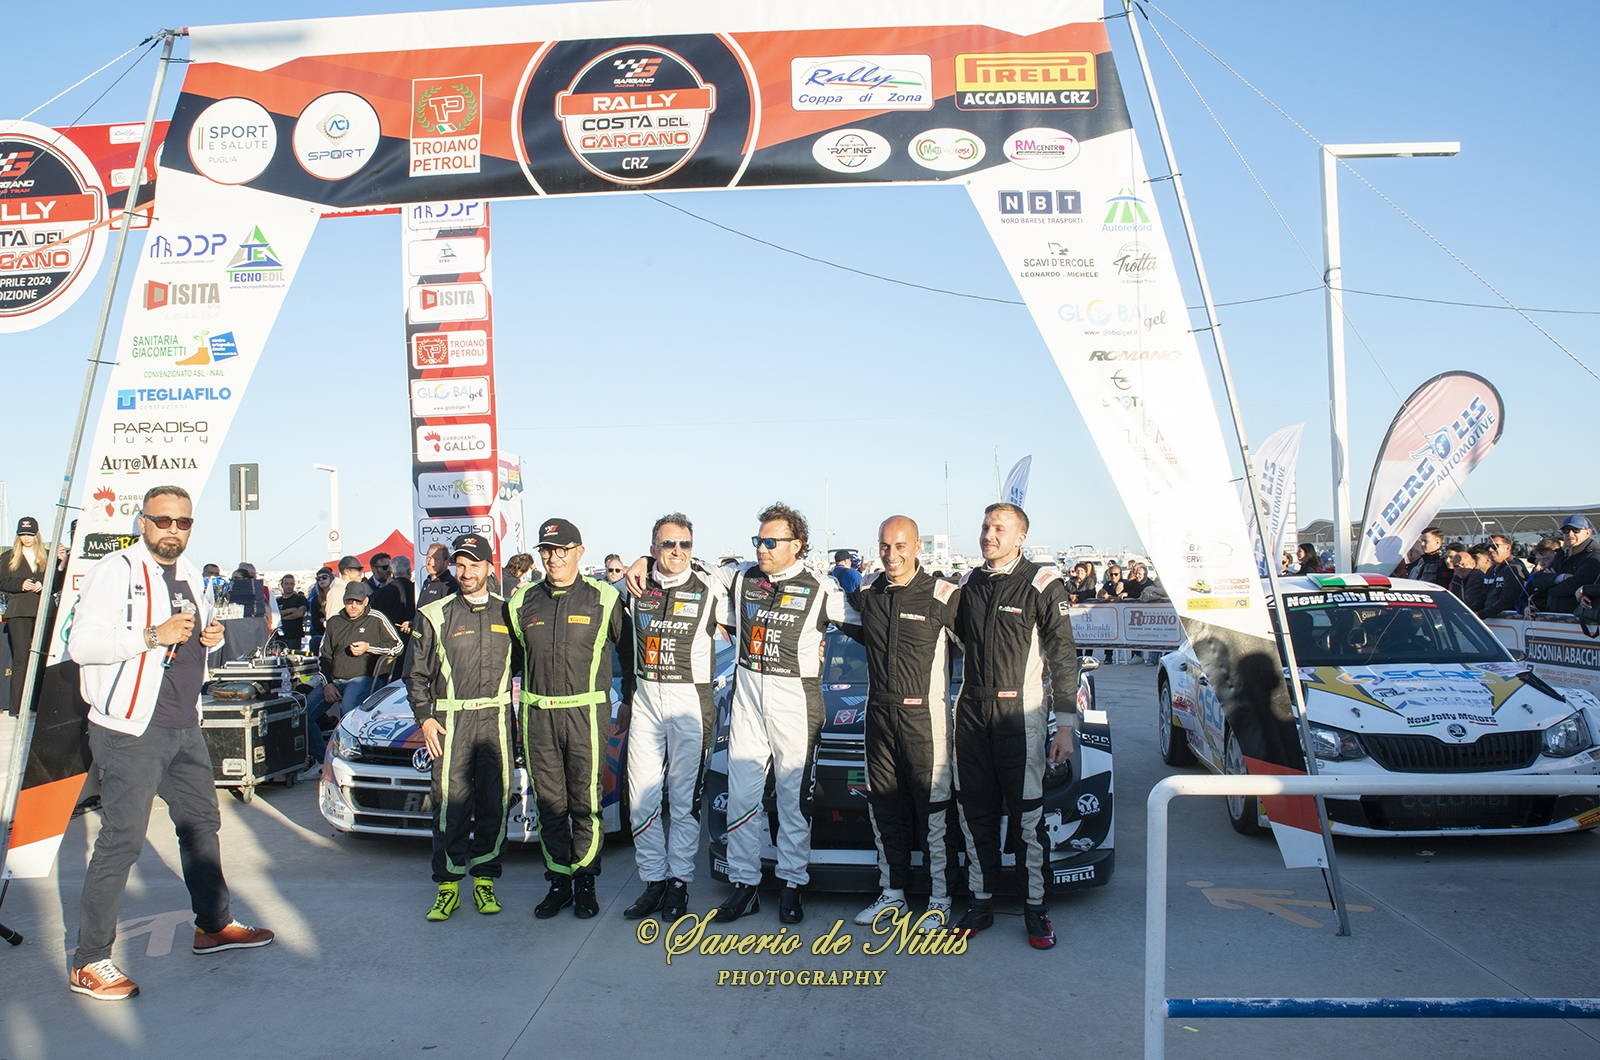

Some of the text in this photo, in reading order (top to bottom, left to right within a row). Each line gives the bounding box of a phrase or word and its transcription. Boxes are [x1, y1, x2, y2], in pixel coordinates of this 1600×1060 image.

[964, 56, 1087, 83] PIRELLI
[805, 66, 896, 89] Rally
[593, 93, 678, 112] RALLY
[799, 93, 922, 105] Coppa di Zona
[964, 91, 1090, 106] ACCADEMIA CRZ
[582, 116, 688, 131] COSTA DEL
[210, 125, 268, 139] SPORT
[208, 140, 268, 150] E SALUTE
[413, 138, 478, 155] TROIANO
[582, 132, 689, 149] GARGANO
[308, 148, 365, 160] SPORT
[830, 146, 873, 154] RACING
[413, 155, 476, 172] PETROLI
[622, 156, 649, 170] CRZ
[0, 201, 56, 222] LLY
[1102, 224, 1153, 232] Autorekord
[34, 232, 70, 246] DEL
[1024, 258, 1095, 267] SCAVI D'ERCOLE
[1112, 252, 1157, 276] Trotta
[28, 276, 52, 286] 2024
[226, 268, 286, 282] TECNOEDIL
[1144, 310, 1168, 331] gel
[133, 335, 178, 347] SANITARIA
[450, 339, 484, 348] TROIANO
[132, 346, 186, 358] GIACOMETTI
[450, 349, 484, 358] PETROLI
[1088, 350, 1182, 362] ROMANO
[144, 370, 192, 378] CONVENZIONATO
[137, 387, 232, 402] TEGLIAFILO
[114, 421, 208, 434] PARADISO
[114, 436, 208, 444] luxury
[444, 441, 486, 452] GALLO
[1435, 412, 1496, 486] AUTOMOTIVE
[422, 524, 492, 536] PARADISO
[1287, 591, 1434, 608] New Jolly Motors
[1128, 610, 1177, 626] RUBINO
[1529, 643, 1562, 662] AUSONIA
[1407, 712, 1497, 724] New Jolly Motors
[1054, 865, 1095, 884] PIRELLI
